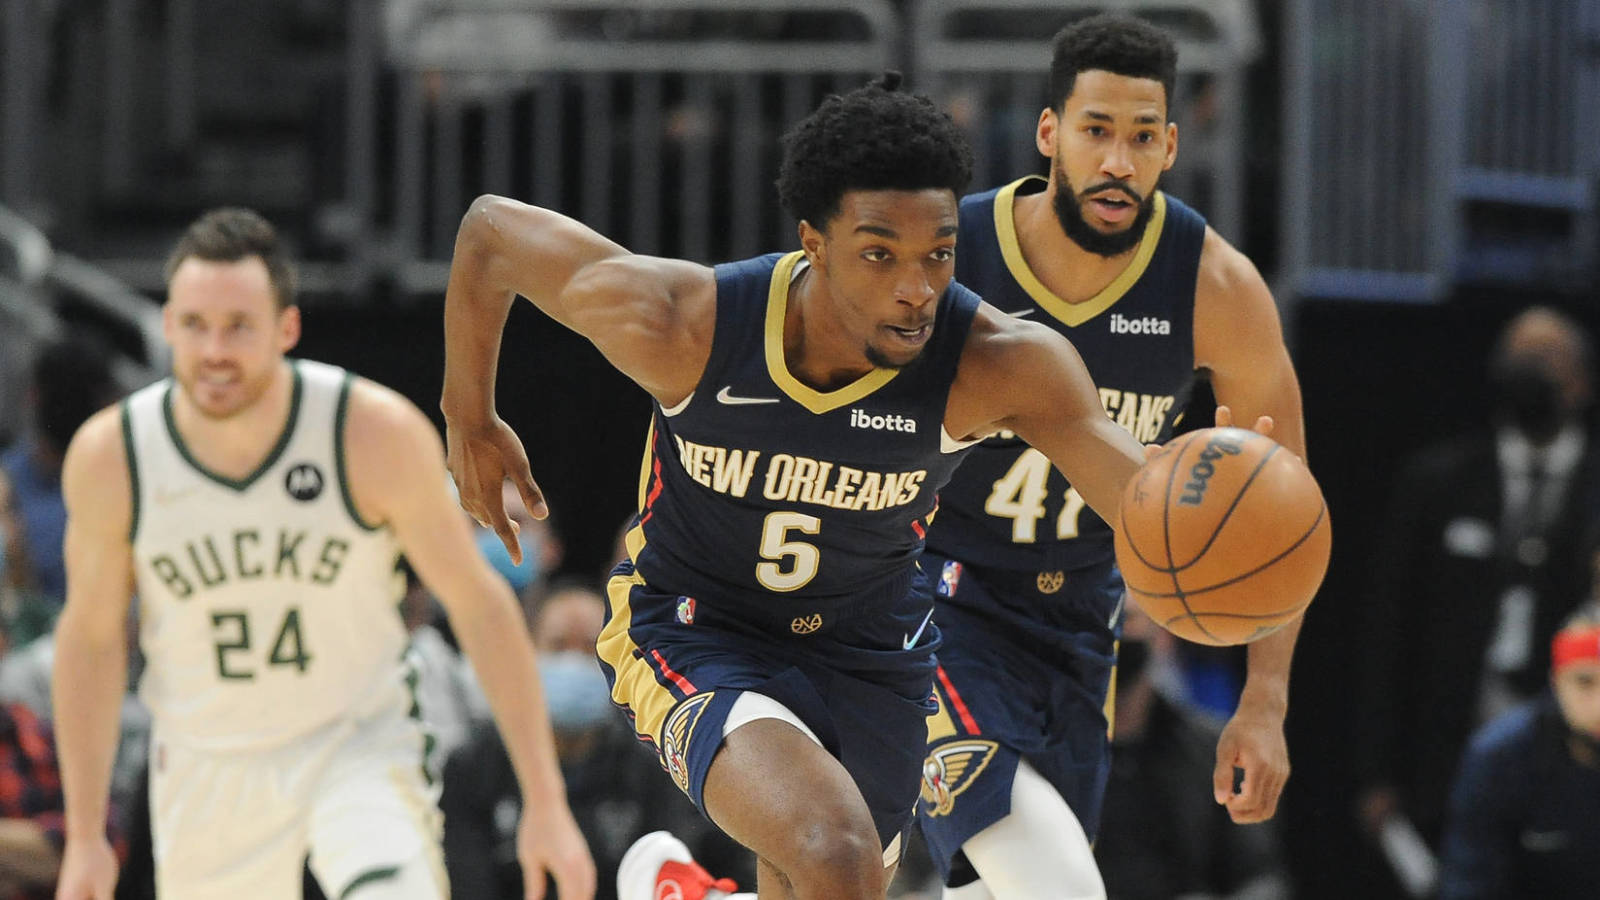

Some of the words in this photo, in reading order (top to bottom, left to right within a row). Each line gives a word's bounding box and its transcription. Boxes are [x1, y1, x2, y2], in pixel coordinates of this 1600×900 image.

[1110, 314, 1171, 335] ibotta
[850, 409, 917, 433] ibotta
[1098, 387, 1175, 443] EANS
[673, 433, 761, 498] NEW
[763, 453, 927, 511] ORLEANS
[151, 529, 349, 600] BUCKS
[755, 511, 822, 593] 5
[211, 608, 312, 681] 24
